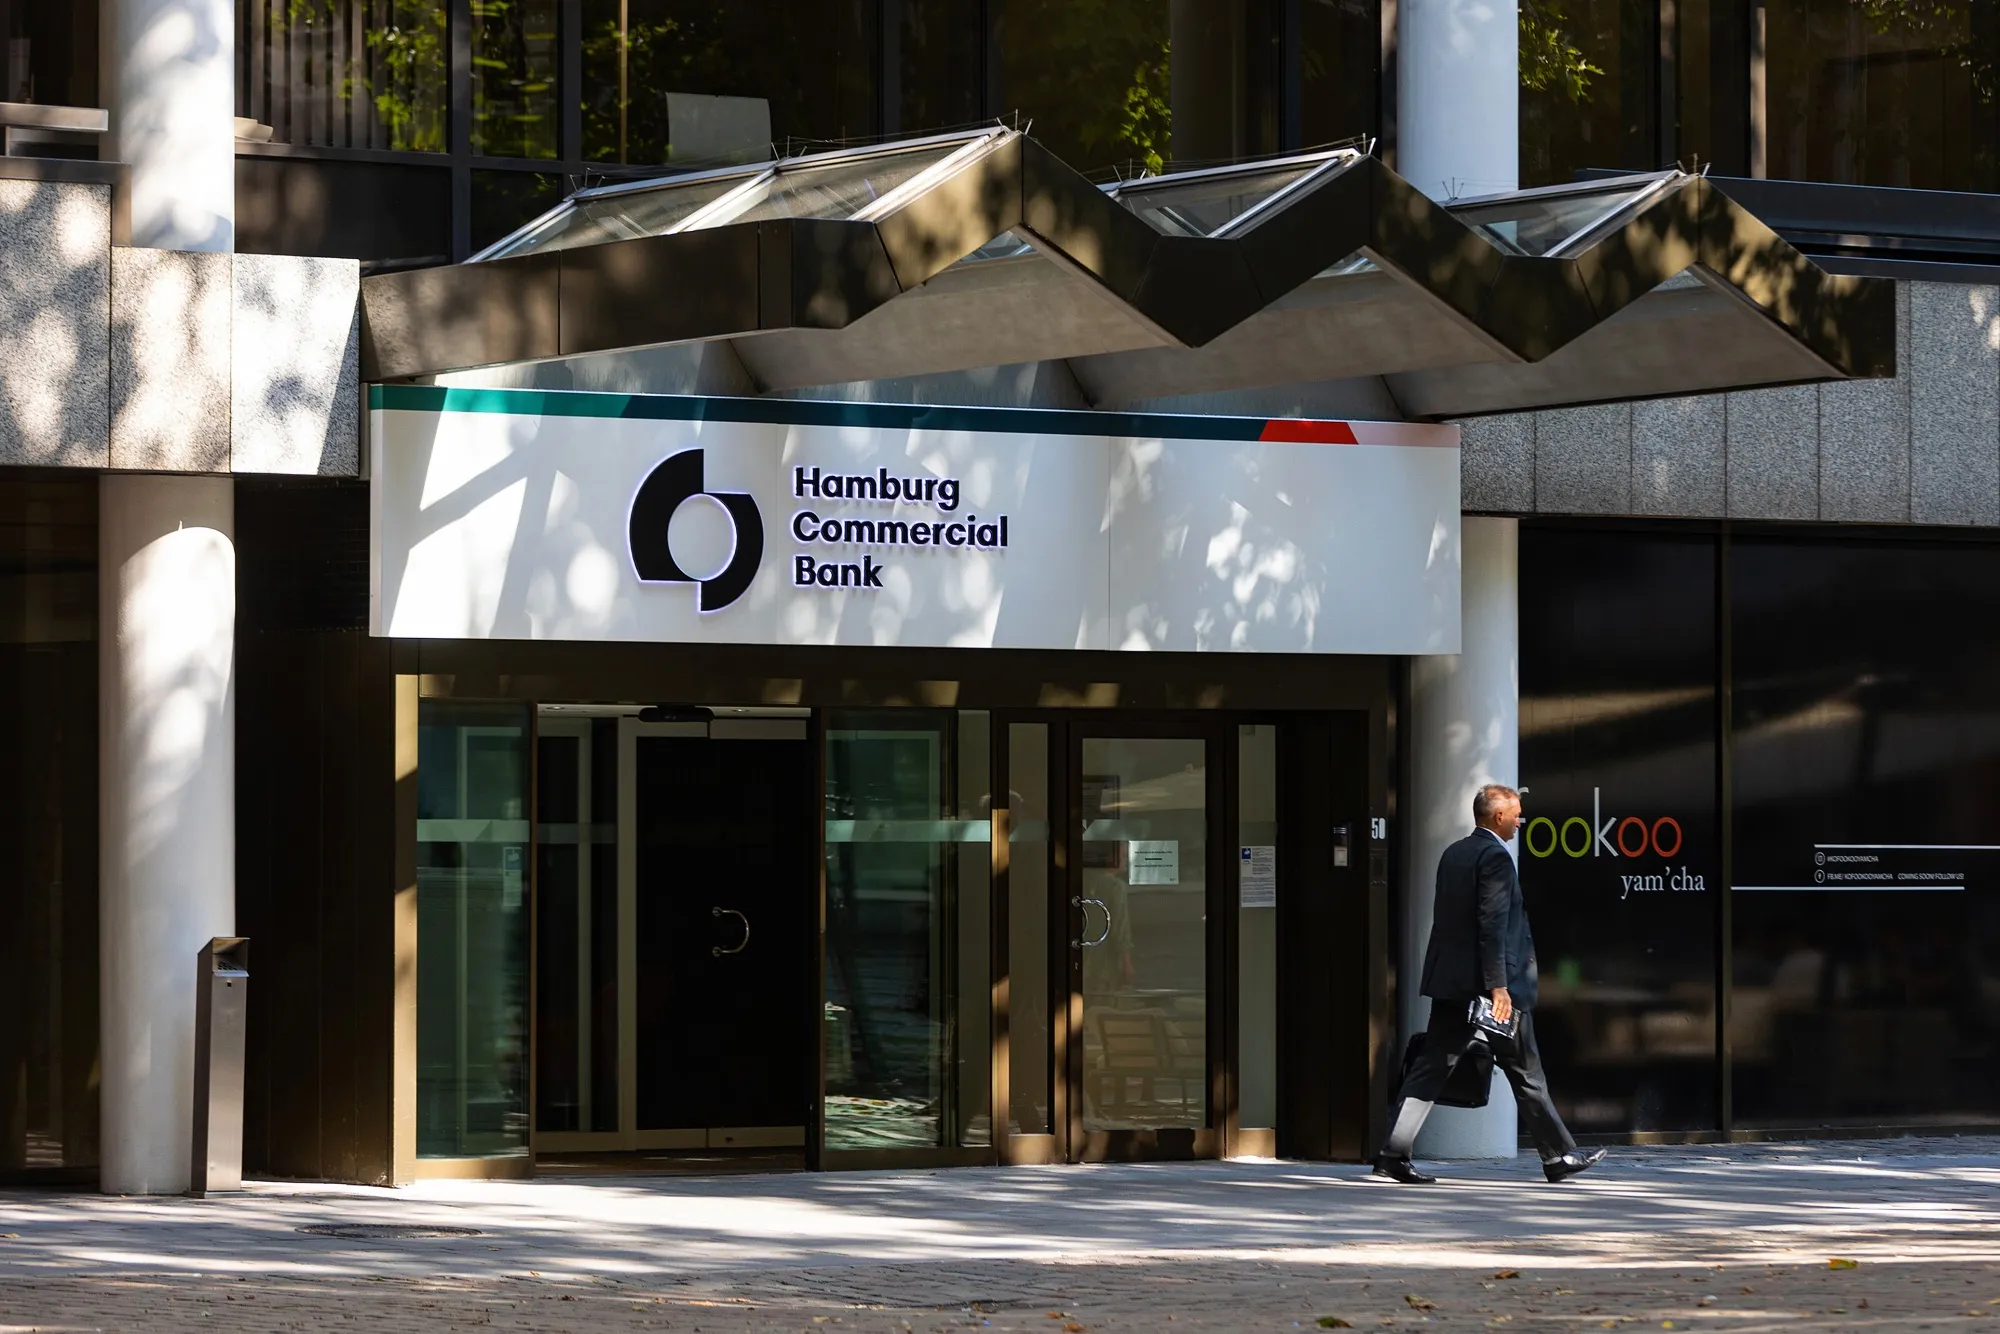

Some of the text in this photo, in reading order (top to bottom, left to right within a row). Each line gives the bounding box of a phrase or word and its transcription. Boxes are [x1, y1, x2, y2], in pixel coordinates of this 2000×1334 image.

[795, 467, 960, 511] Hamburg
[792, 511, 1008, 547] Commercial
[795, 555, 883, 587] Bank
[1371, 817, 1386, 840] 50
[1518, 786, 1682, 858] ookoo
